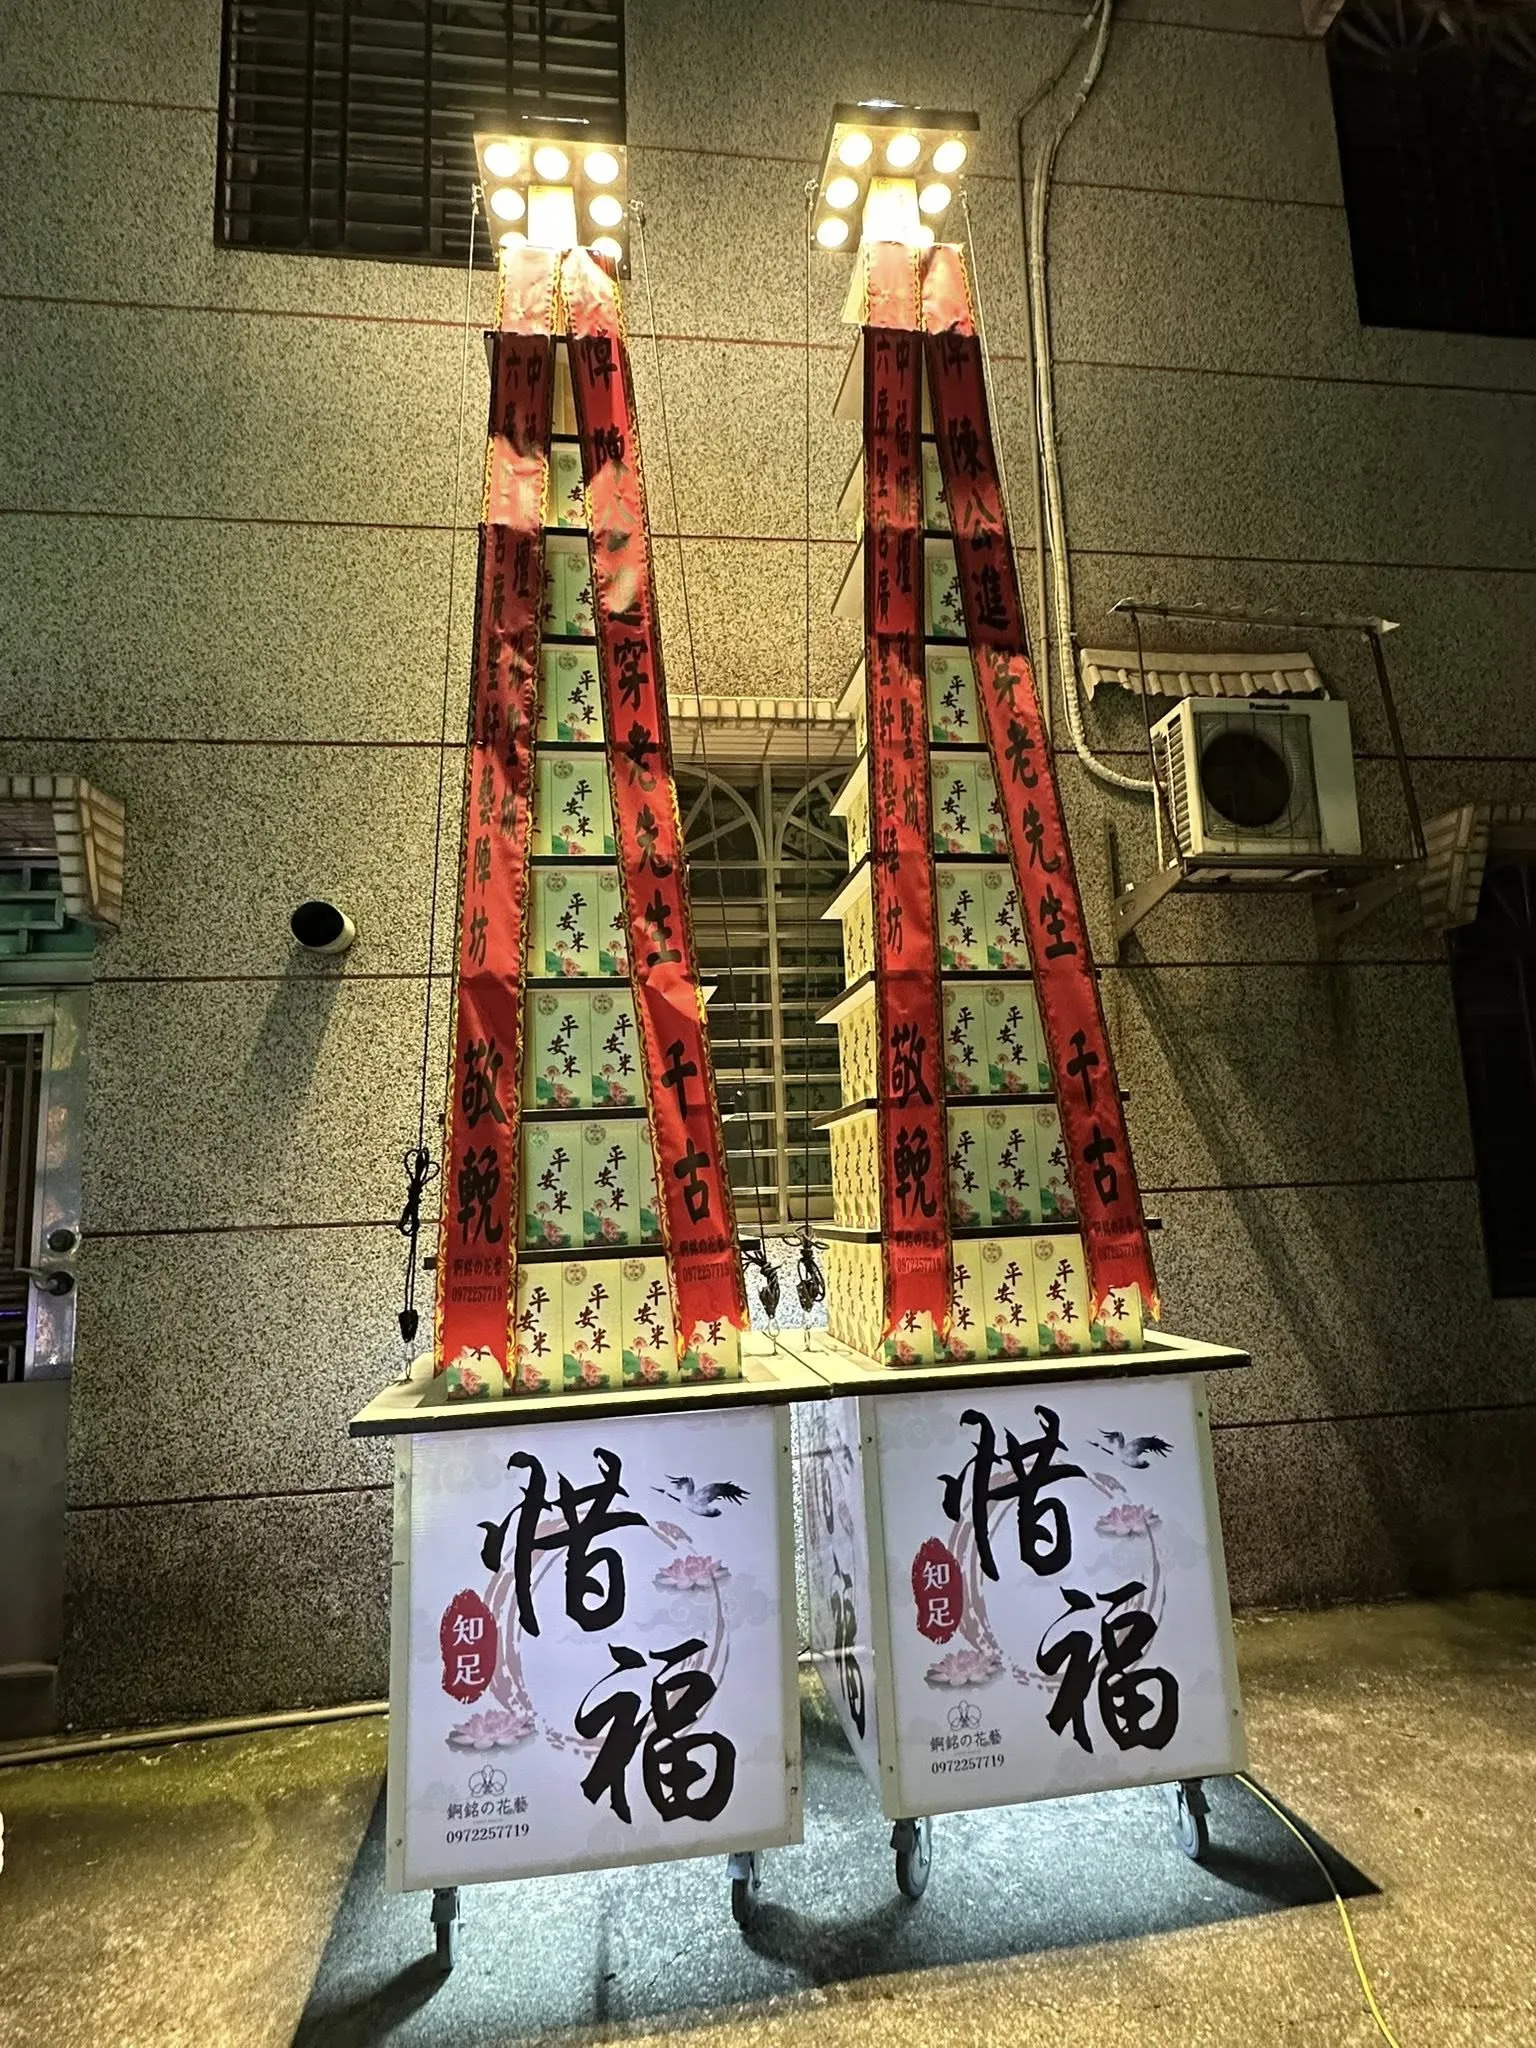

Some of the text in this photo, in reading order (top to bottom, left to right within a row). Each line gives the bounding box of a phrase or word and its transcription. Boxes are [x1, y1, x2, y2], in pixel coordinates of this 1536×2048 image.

[567, 669, 598, 725] 平安米
[940, 675, 969, 728] 平安米
[562, 779, 594, 837] 平安米
[941, 780, 971, 835] 平安米
[556, 892, 589, 953] 平安米
[947, 890, 978, 947] 平安米
[995, 890, 1024, 947] 平安米
[547, 1014, 581, 1078] 平安米
[602, 1013, 636, 1077] 平安米
[948, 1006, 978, 1067] 平安米
[997, 1005, 1028, 1066] 平安米
[537, 1148, 572, 1215] 平安米
[594, 1145, 629, 1212] 平安米
[949, 1130, 979, 1193] 平安米
[998, 1128, 1030, 1191] 平安米
[516, 1286, 551, 1357] 平安米
[575, 1283, 611, 1354] 平安米
[634, 1280, 669, 1350] 平安米
[994, 1261, 1027, 1327] 平安米
[1046, 1258, 1079, 1324] 平安米
[922, 1559, 953, 1625] 知足
[937, 1405, 1180, 1752] 惜福
[452, 1612, 487, 1686] 知足
[477, 1448, 737, 1824] 惜福
[931, 1753, 1005, 1774] 0972257719
[446, 1824, 529, 1844] 0972257719
